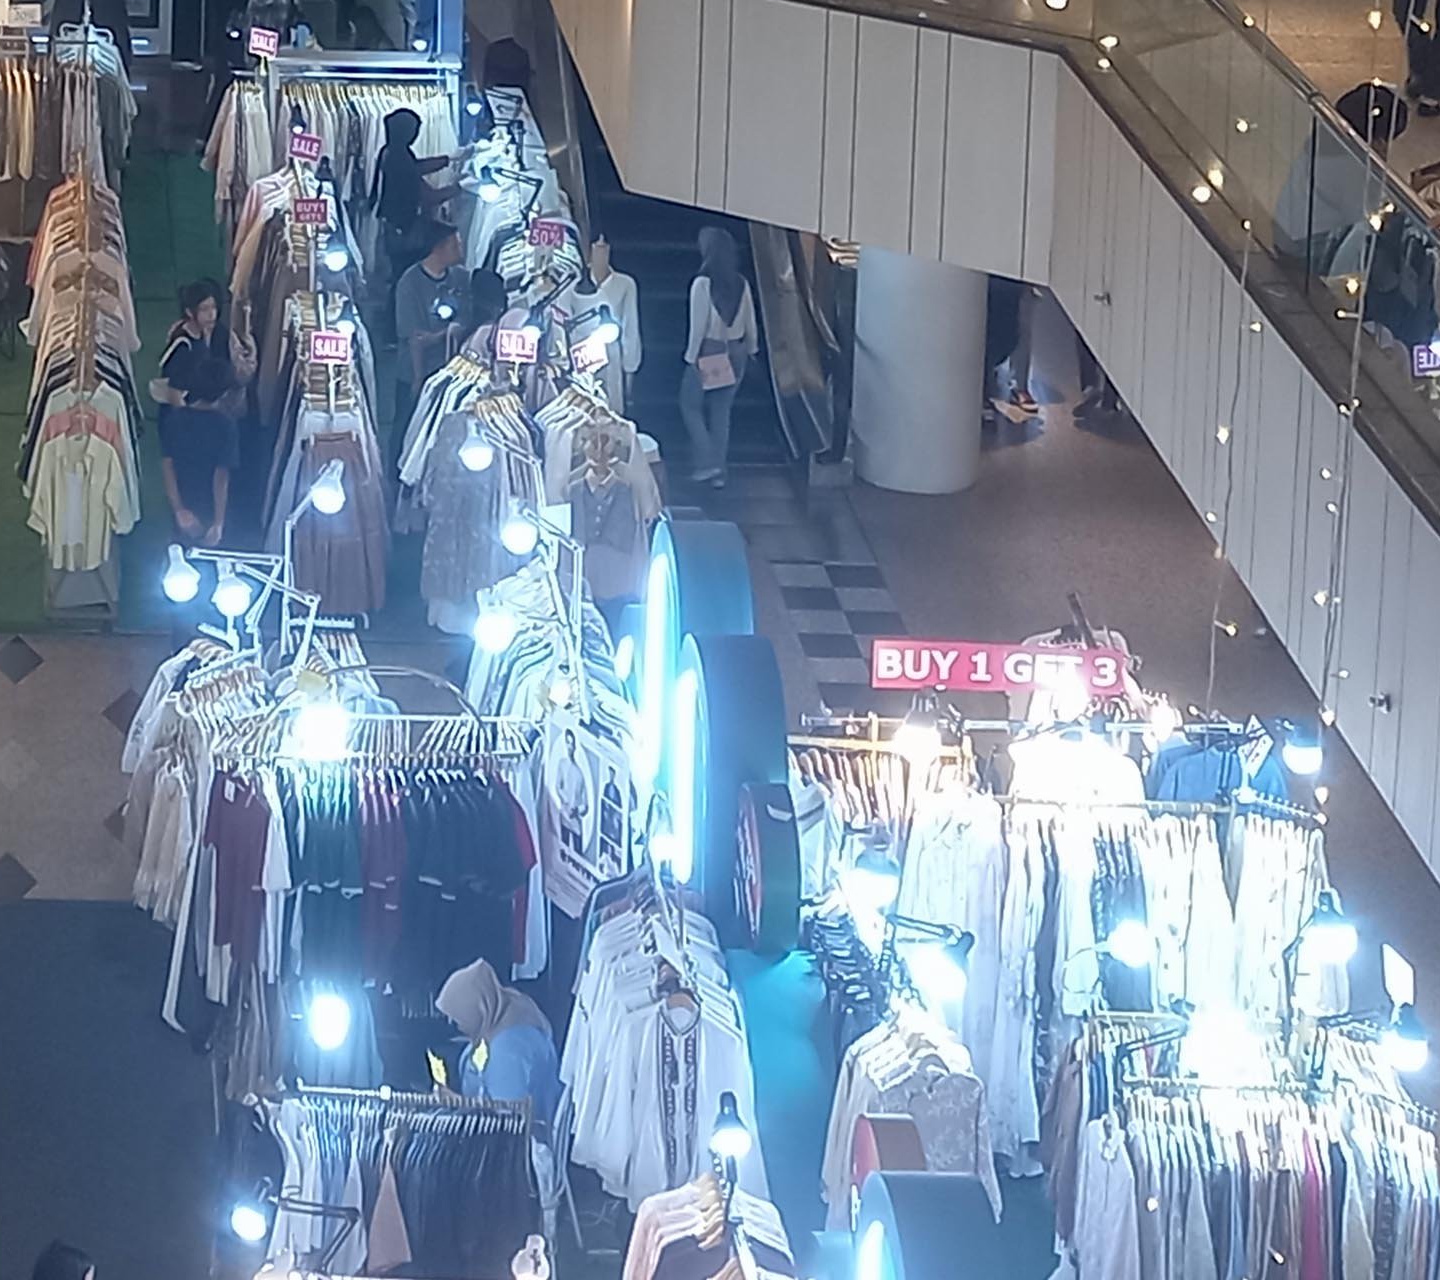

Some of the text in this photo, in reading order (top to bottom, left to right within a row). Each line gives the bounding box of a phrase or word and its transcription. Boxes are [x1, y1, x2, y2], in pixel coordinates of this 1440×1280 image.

[292, 138, 320, 158] SALE
[314, 338, 347, 358] SALE
[876, 648, 1118, 688] BUY 1 GET 3
